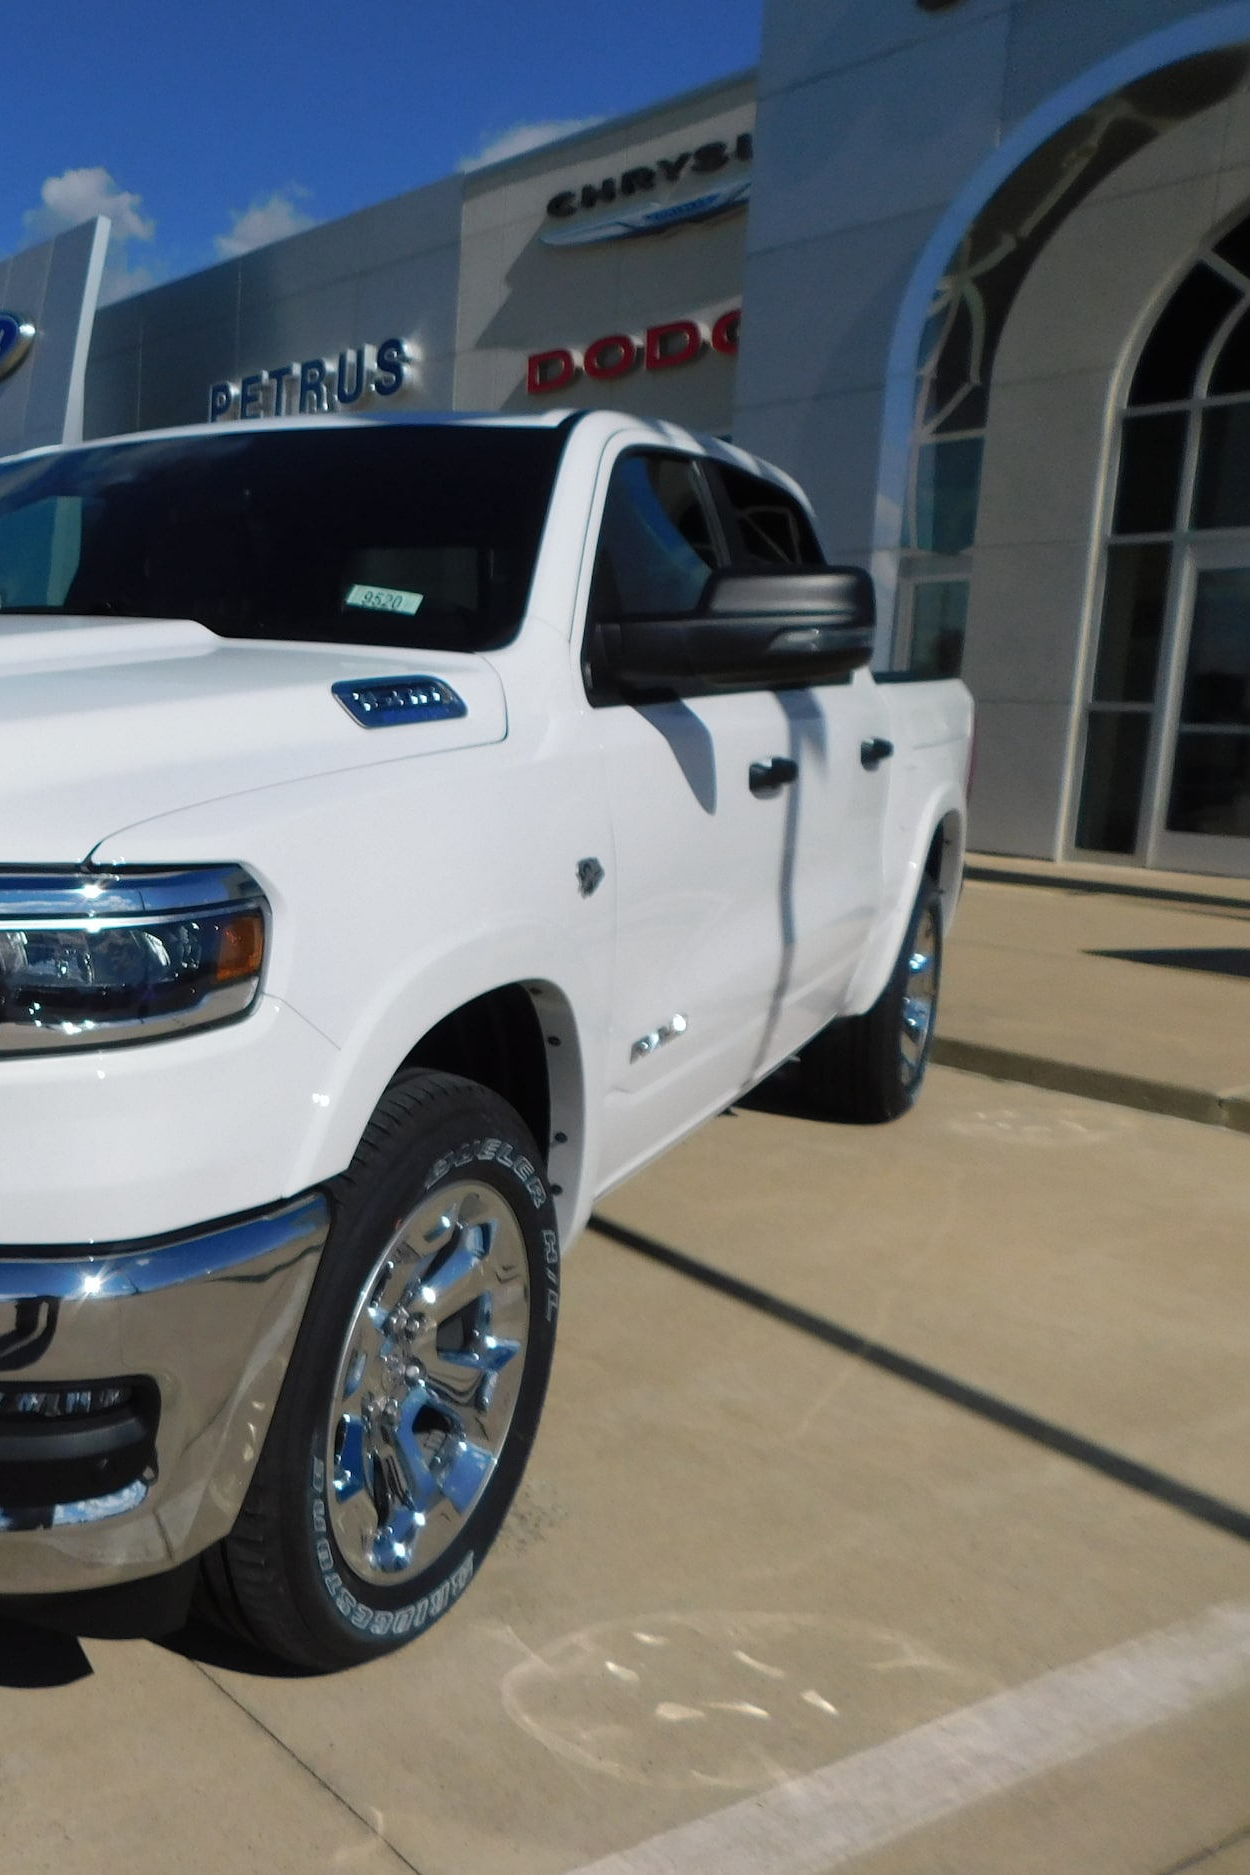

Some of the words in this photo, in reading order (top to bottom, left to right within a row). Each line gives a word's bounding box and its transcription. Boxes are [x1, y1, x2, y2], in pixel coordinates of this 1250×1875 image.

[209, 337, 414, 423] PETRUS
[361, 590, 403, 610] 9520
[312, 1455, 475, 1636] BRIDGESTONE
